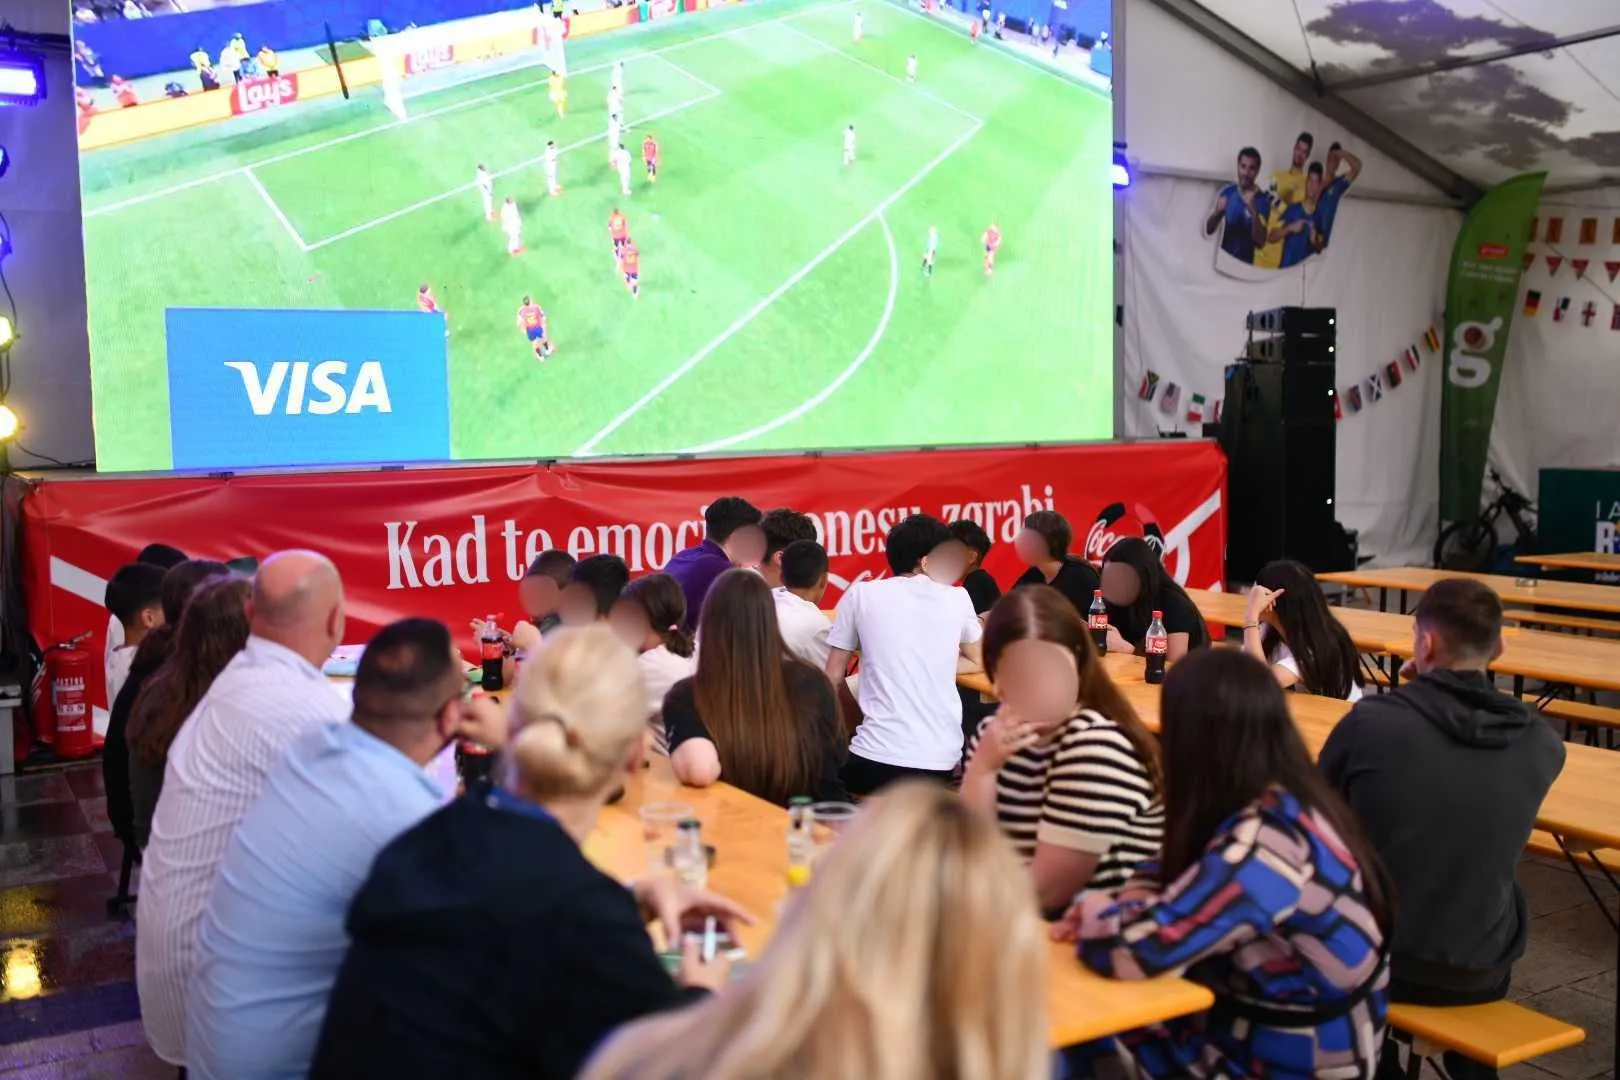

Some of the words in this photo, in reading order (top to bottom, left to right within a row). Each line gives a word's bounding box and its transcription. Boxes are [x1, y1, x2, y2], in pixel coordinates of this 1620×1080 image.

[223, 360, 393, 416] VISA
[384, 514, 490, 590] Kad
[501, 519, 553, 581] te
